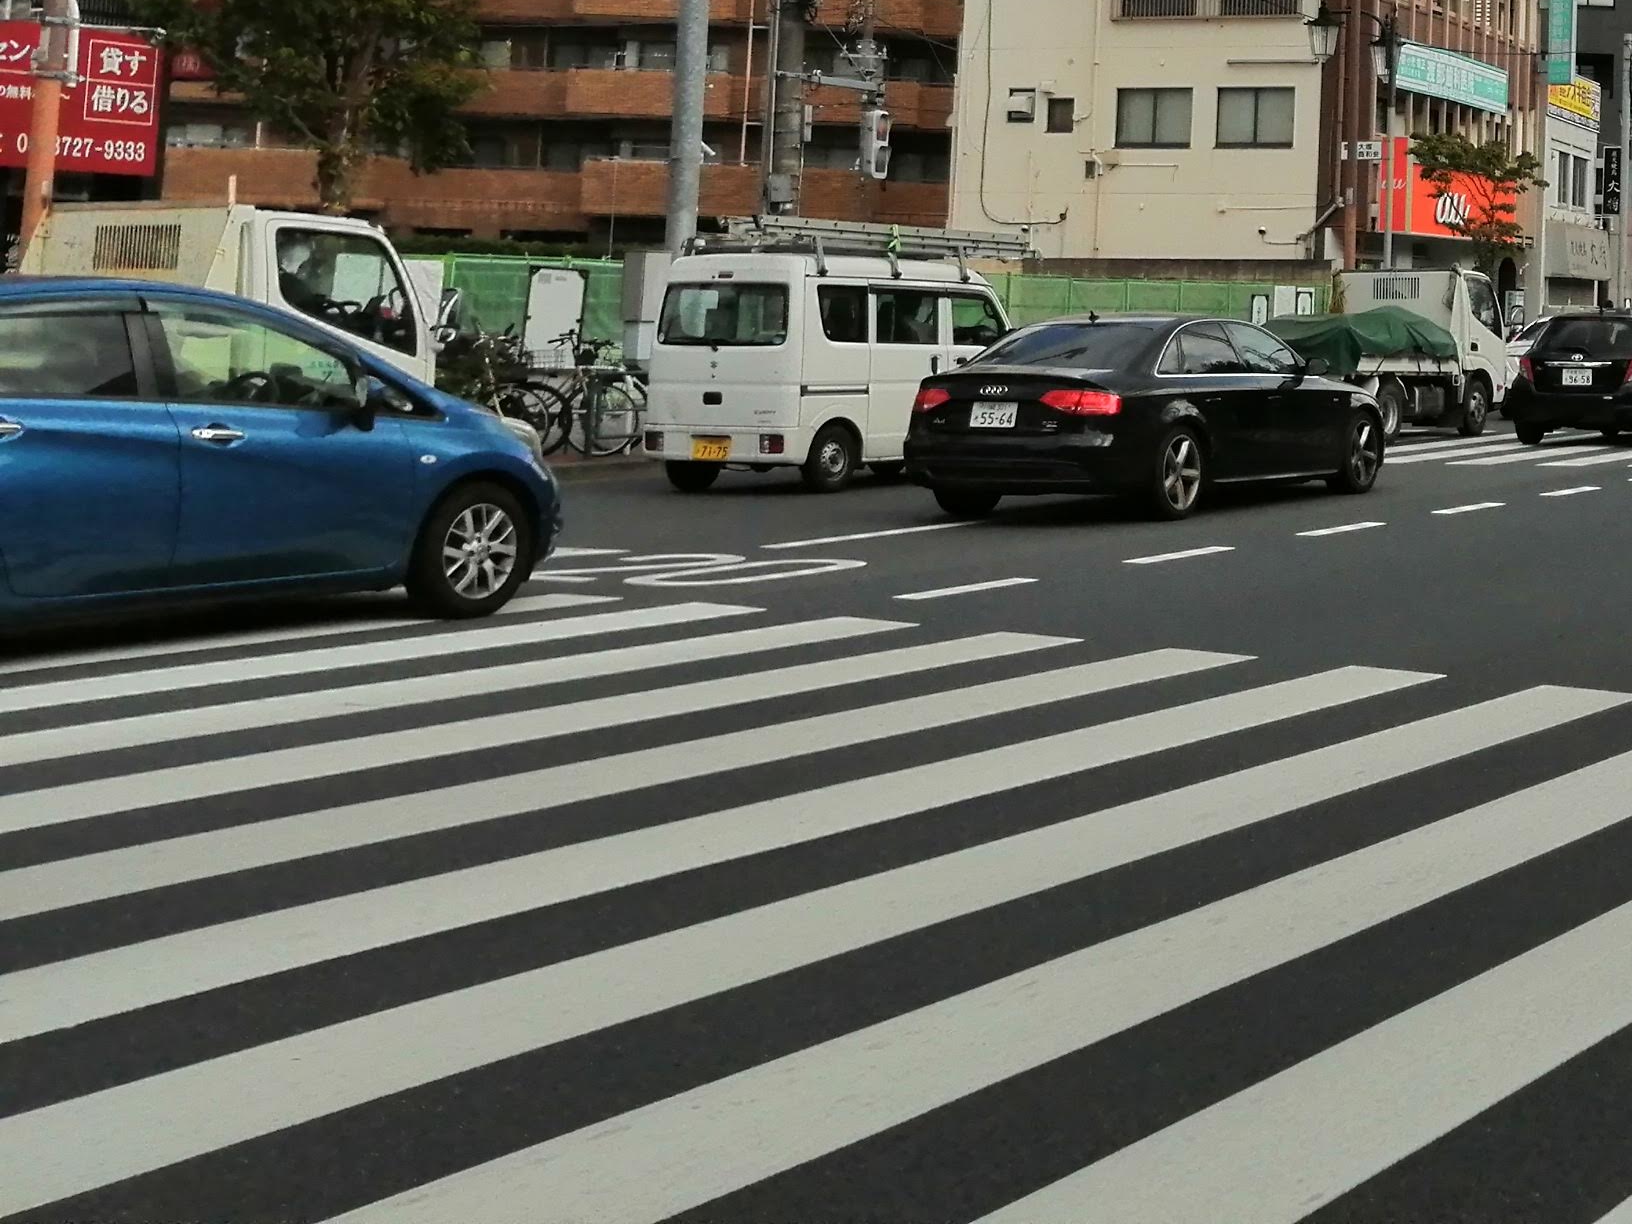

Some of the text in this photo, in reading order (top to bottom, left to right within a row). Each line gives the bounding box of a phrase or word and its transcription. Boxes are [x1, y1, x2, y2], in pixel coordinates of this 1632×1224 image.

[100, 47, 146, 75] 貸す
[92, 85, 148, 114] 借りる
[980, 412, 1013, 425] 55-64
